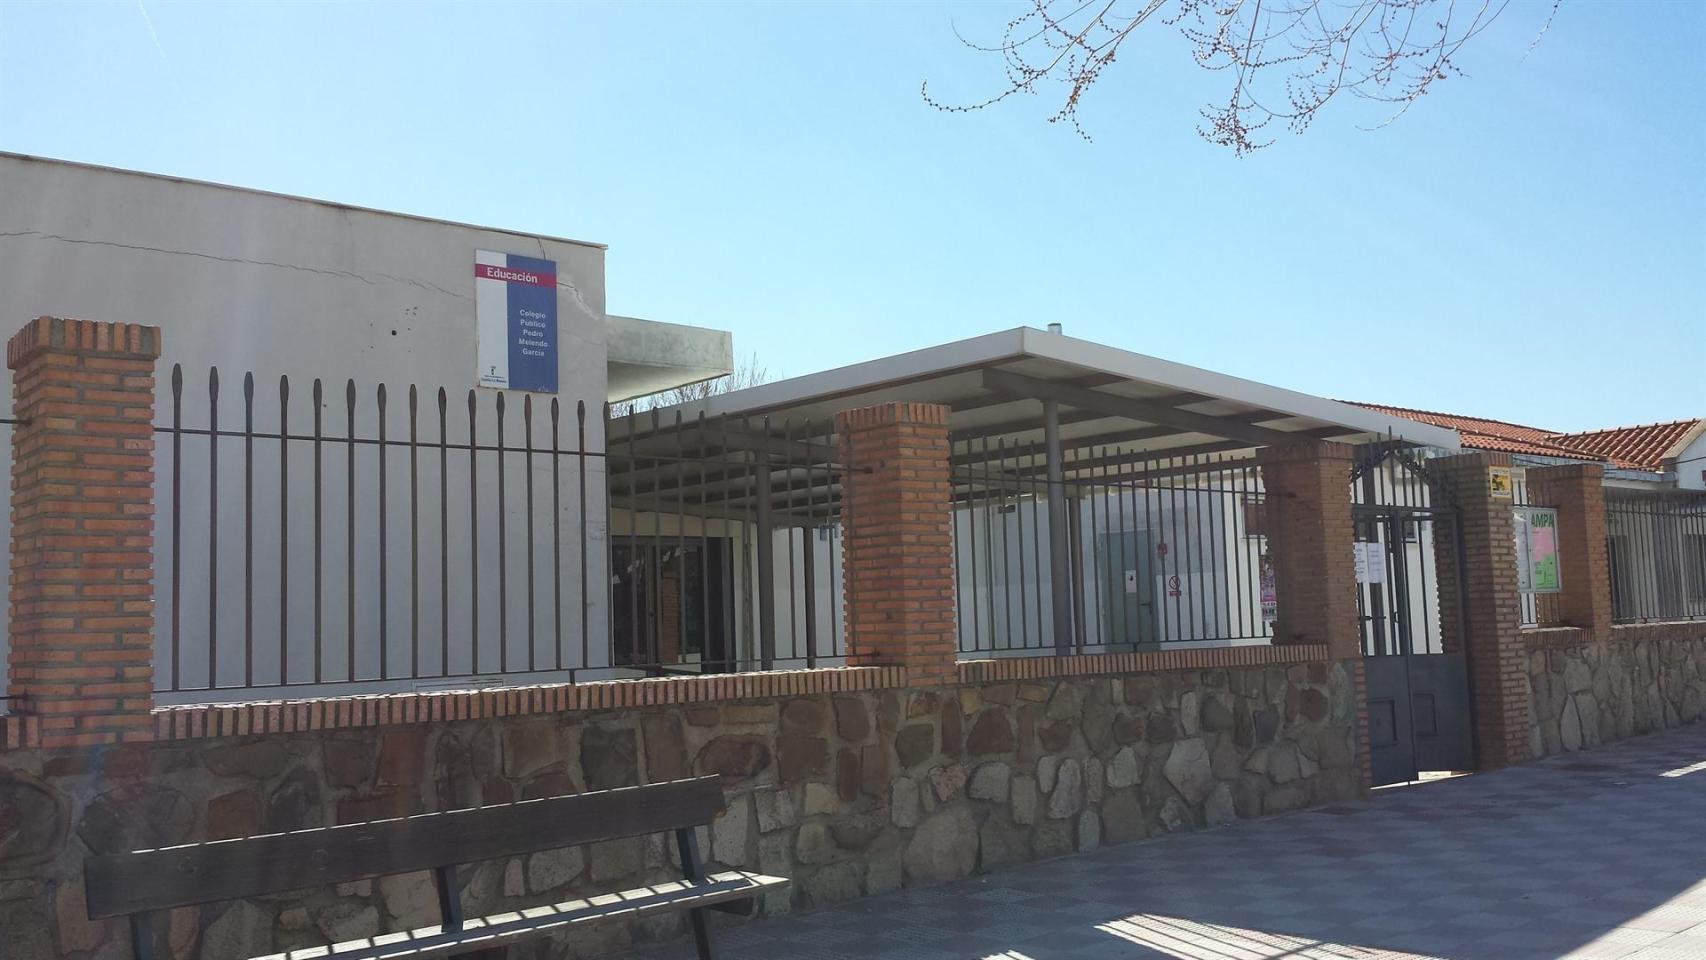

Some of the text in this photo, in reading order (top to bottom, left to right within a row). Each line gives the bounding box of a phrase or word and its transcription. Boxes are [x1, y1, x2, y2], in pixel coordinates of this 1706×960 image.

[487, 267, 538, 283] Educación
[519, 309, 546, 319] Colegio
[520, 319, 546, 328] Público
[523, 329, 544, 337] Pedro
[1531, 513, 1554, 528] AMPA
